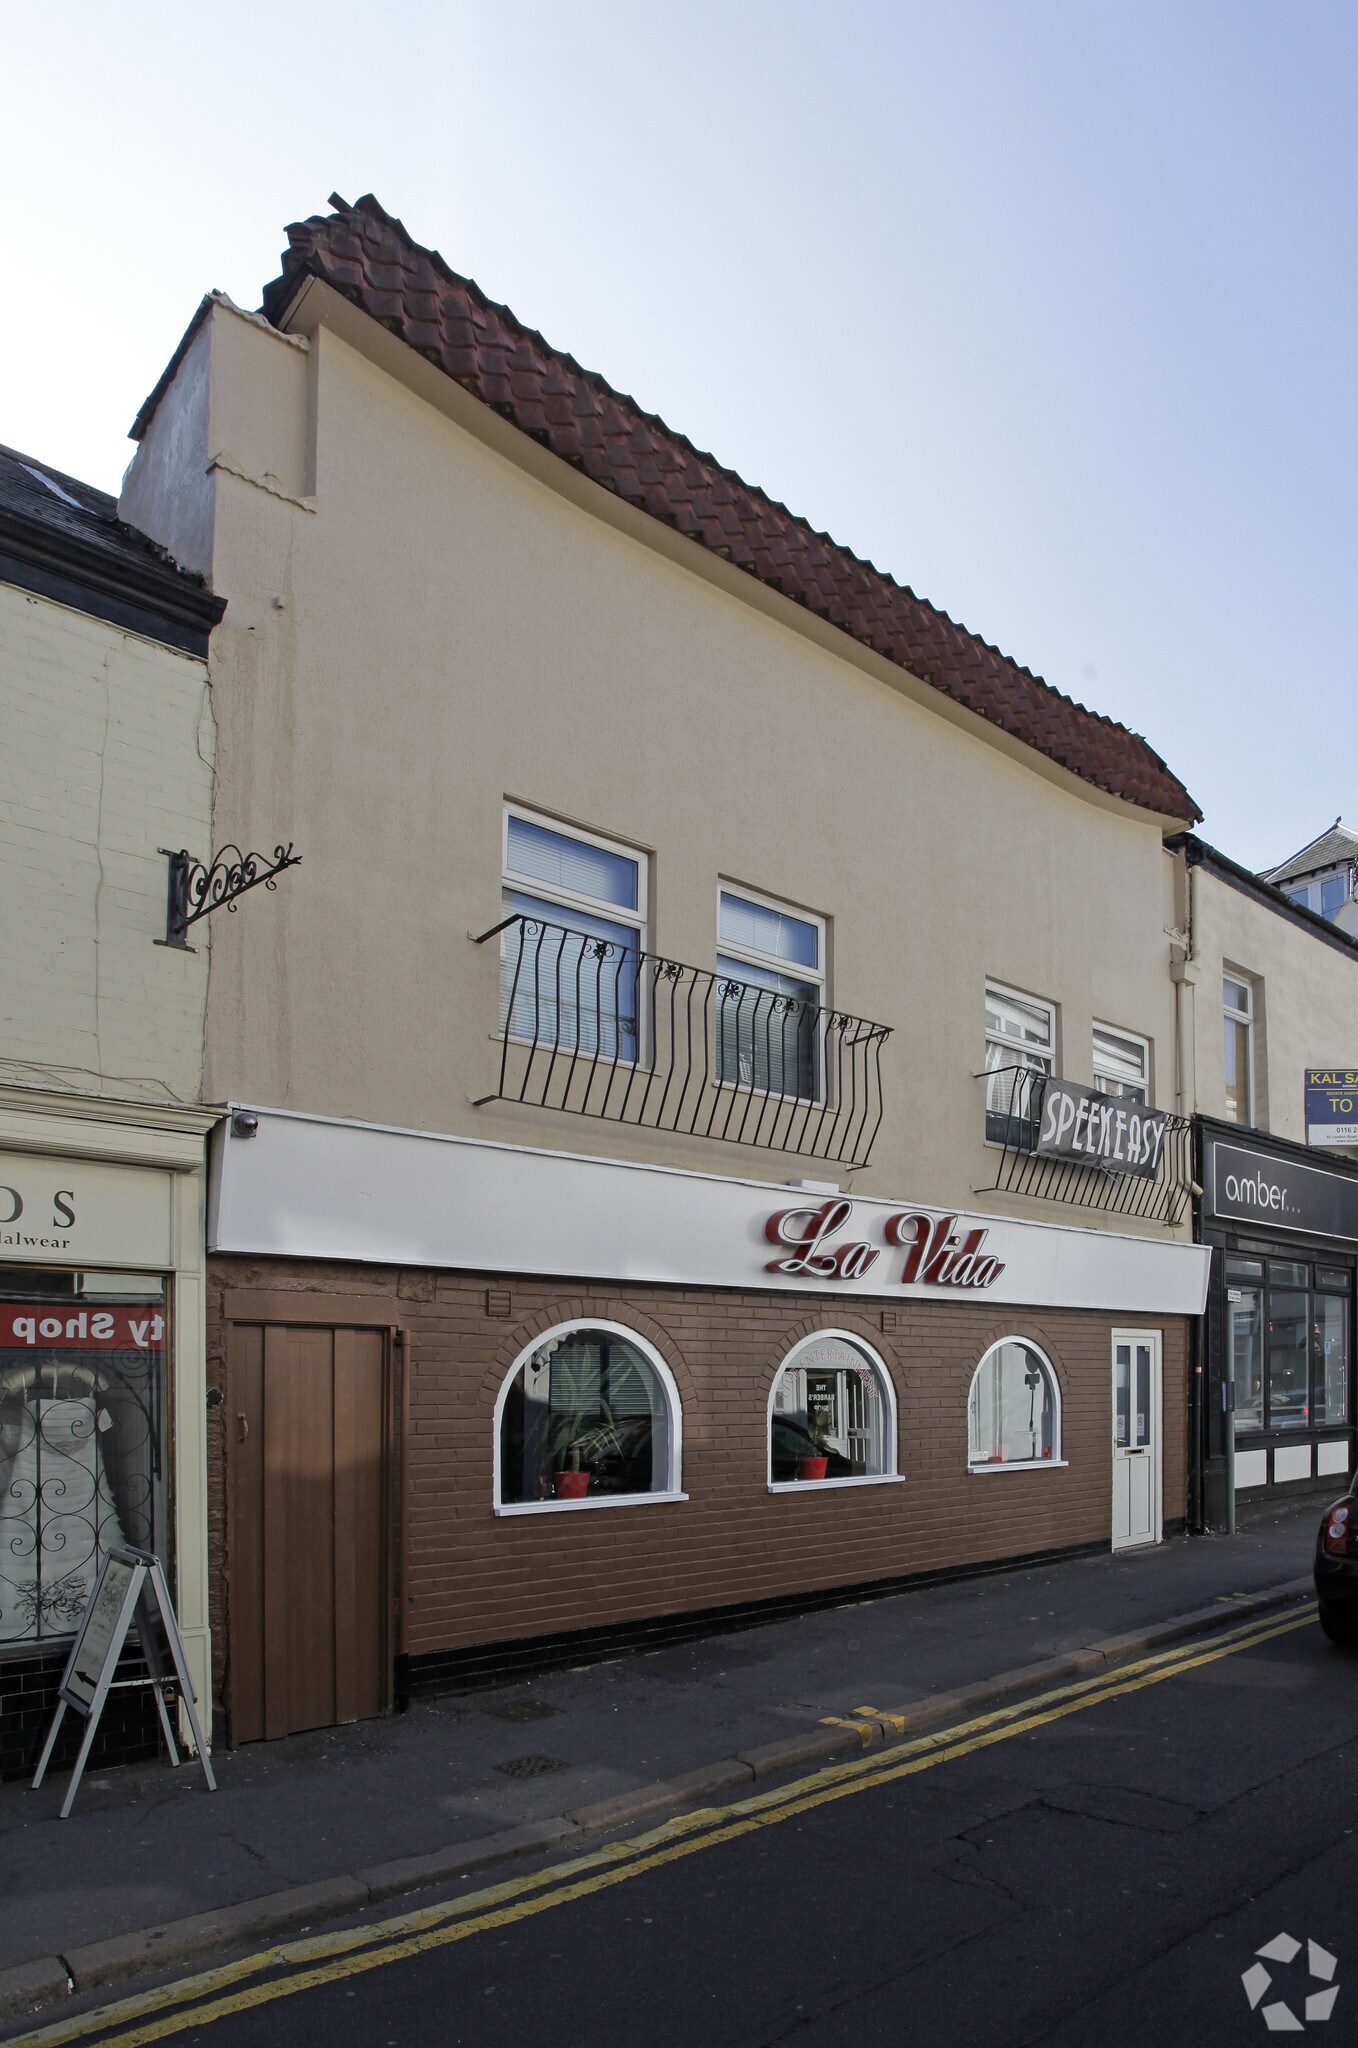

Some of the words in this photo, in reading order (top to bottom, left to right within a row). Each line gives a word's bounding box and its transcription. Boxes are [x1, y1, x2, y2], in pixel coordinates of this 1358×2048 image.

[1310, 1073, 1342, 1084] KAL
[1328, 1098, 1353, 1113] TO
[1042, 1091, 1165, 1169] SPEEKEASY
[0, 1231, 70, 1249] alwear
[765, 1199, 881, 1280] La
[885, 1211, 1006, 1289] Vida
[800, 1347, 879, 1399] ENTERTAINMENT
